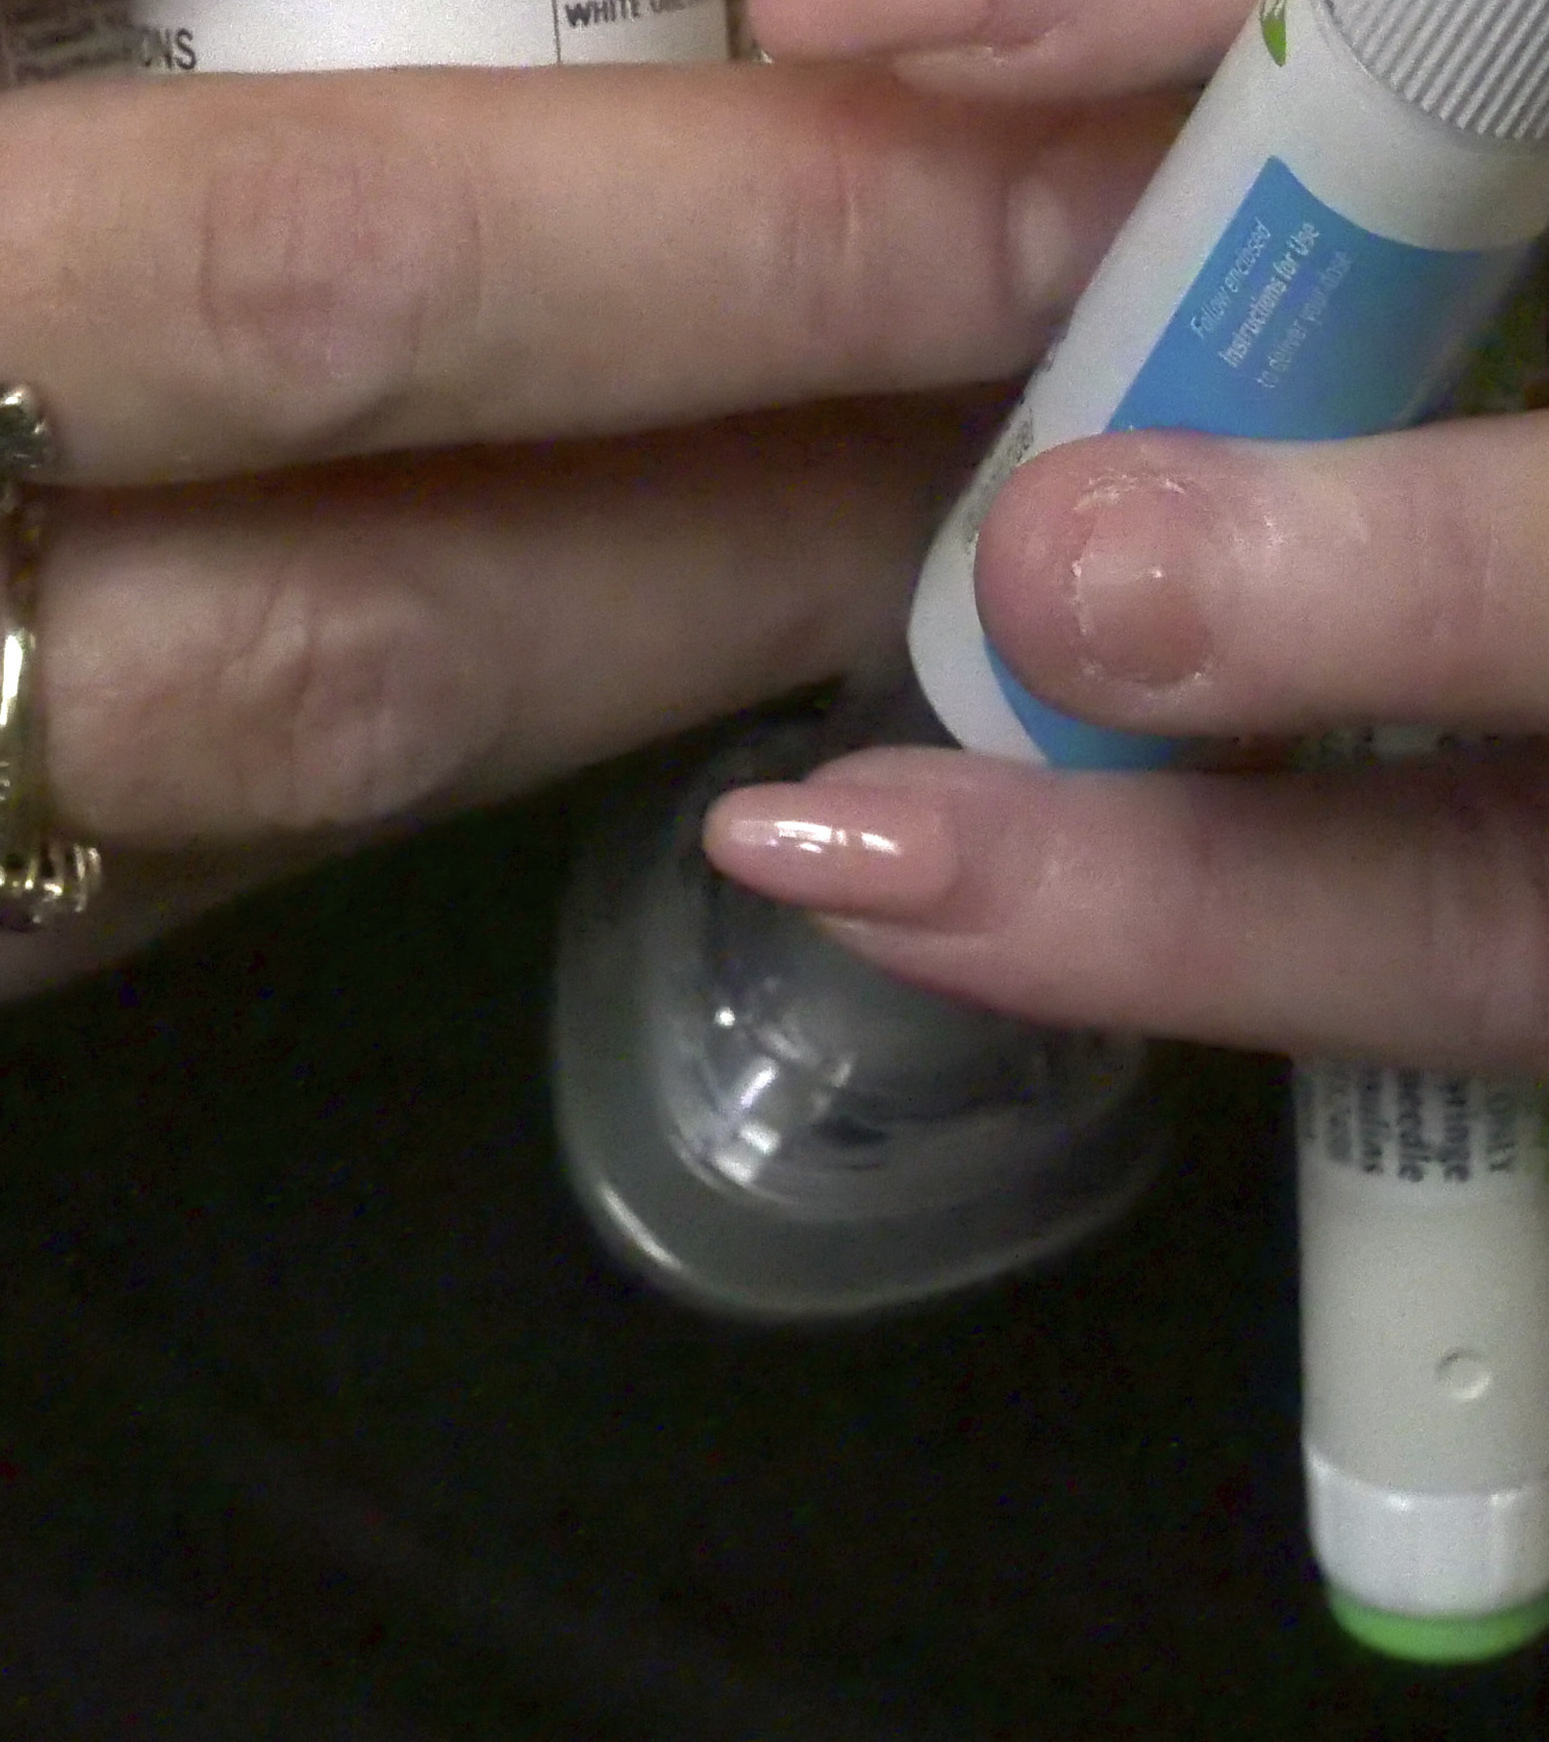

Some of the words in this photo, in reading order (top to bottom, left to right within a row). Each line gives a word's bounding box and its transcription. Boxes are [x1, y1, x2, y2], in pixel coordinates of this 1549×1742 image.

[1190, 286, 1232, 339] Follow
[1224, 216, 1271, 293] enclosed
[1218, 276, 1287, 368] Instructions
[1273, 251, 1298, 281] for
[1286, 222, 1320, 257] Use
